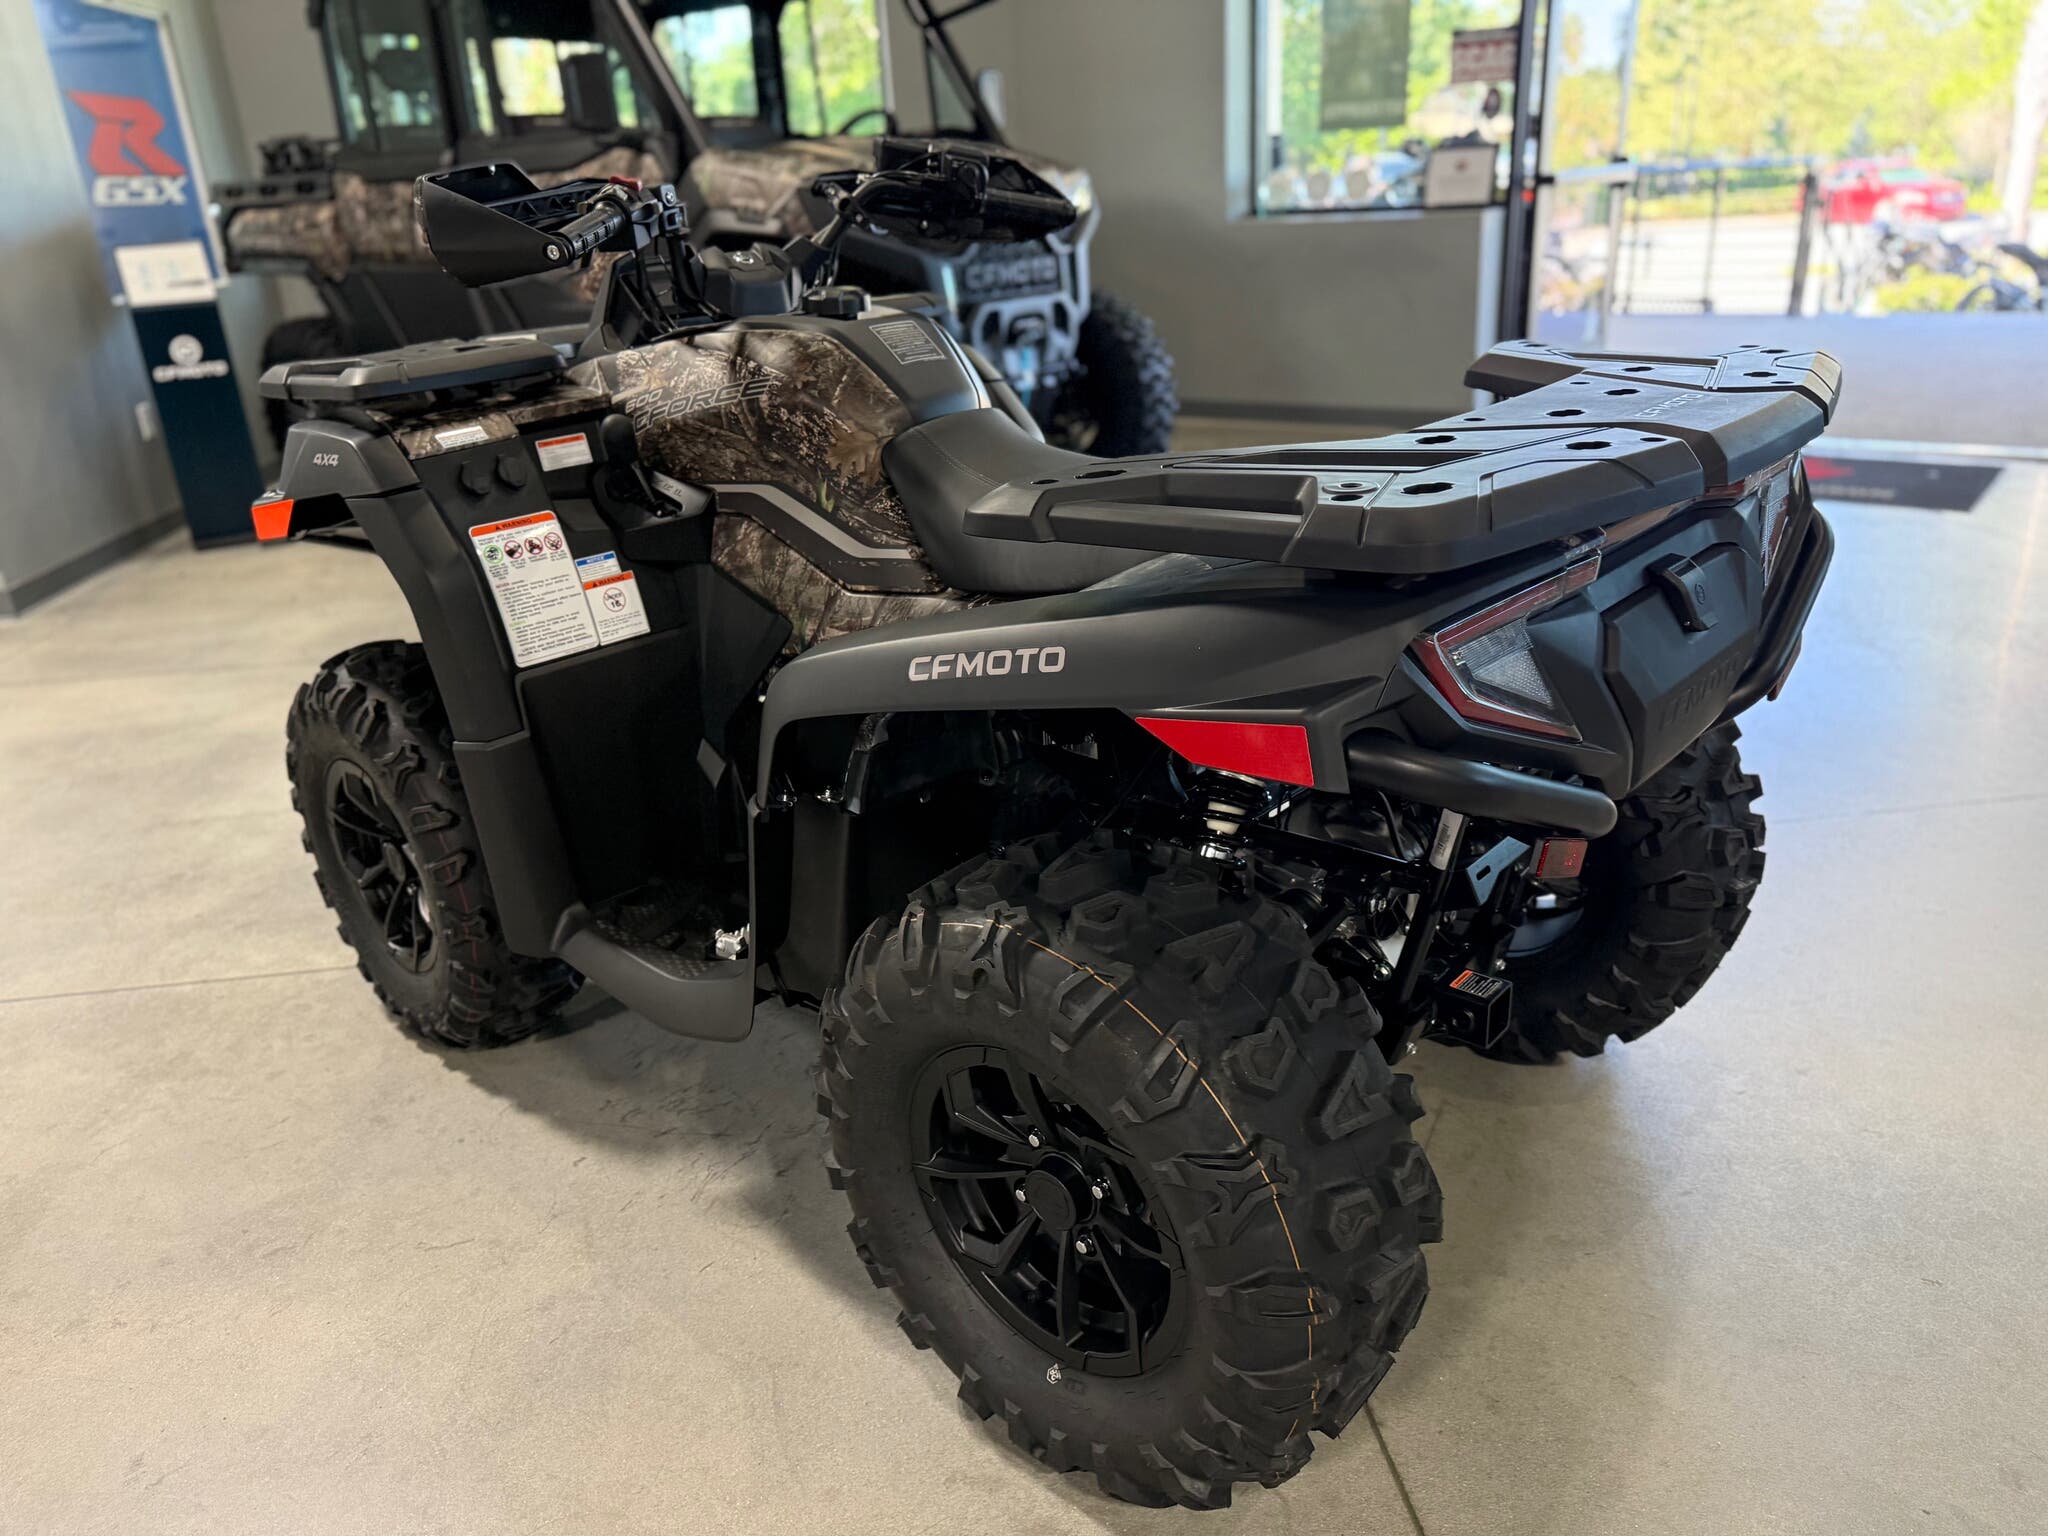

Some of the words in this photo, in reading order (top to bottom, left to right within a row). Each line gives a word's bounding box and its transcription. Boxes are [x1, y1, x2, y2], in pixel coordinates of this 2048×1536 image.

[66, 90, 187, 177] R
[92, 175, 188, 208] GSX
[633, 376, 774, 435] CFORCE
[503, 518, 533, 530] WARNING
[599, 575, 625, 586] WARNING
[908, 646, 1066, 682] CFMOTO
